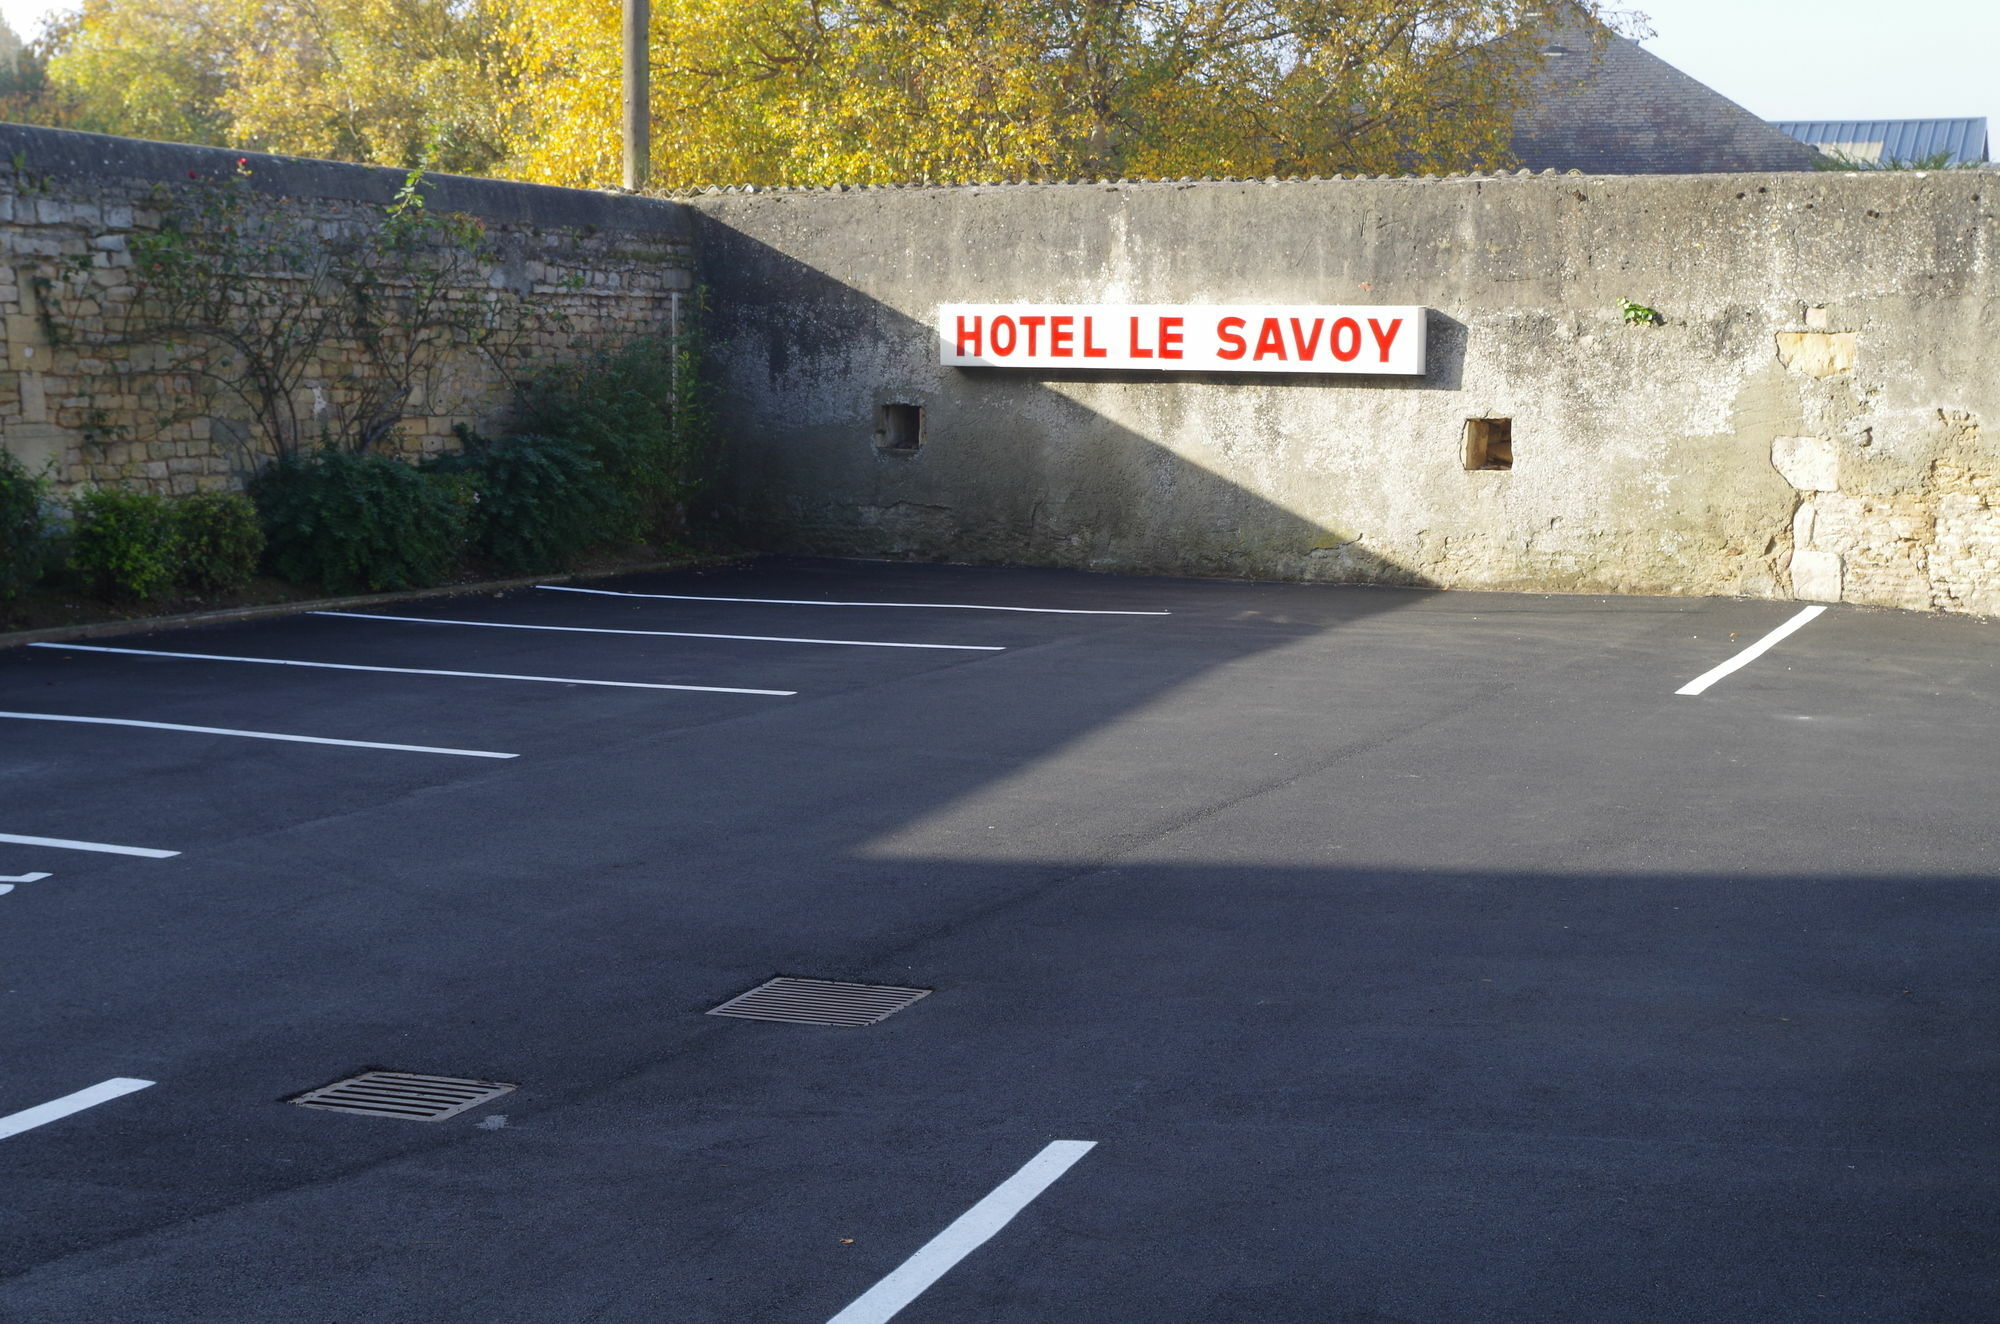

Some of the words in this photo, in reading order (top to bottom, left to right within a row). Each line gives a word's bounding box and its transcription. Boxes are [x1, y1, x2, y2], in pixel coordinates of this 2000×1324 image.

[956, 315, 1107, 358] HOTEL
[1129, 316, 1184, 360] LE
[1216, 316, 1403, 363] SAVOY
